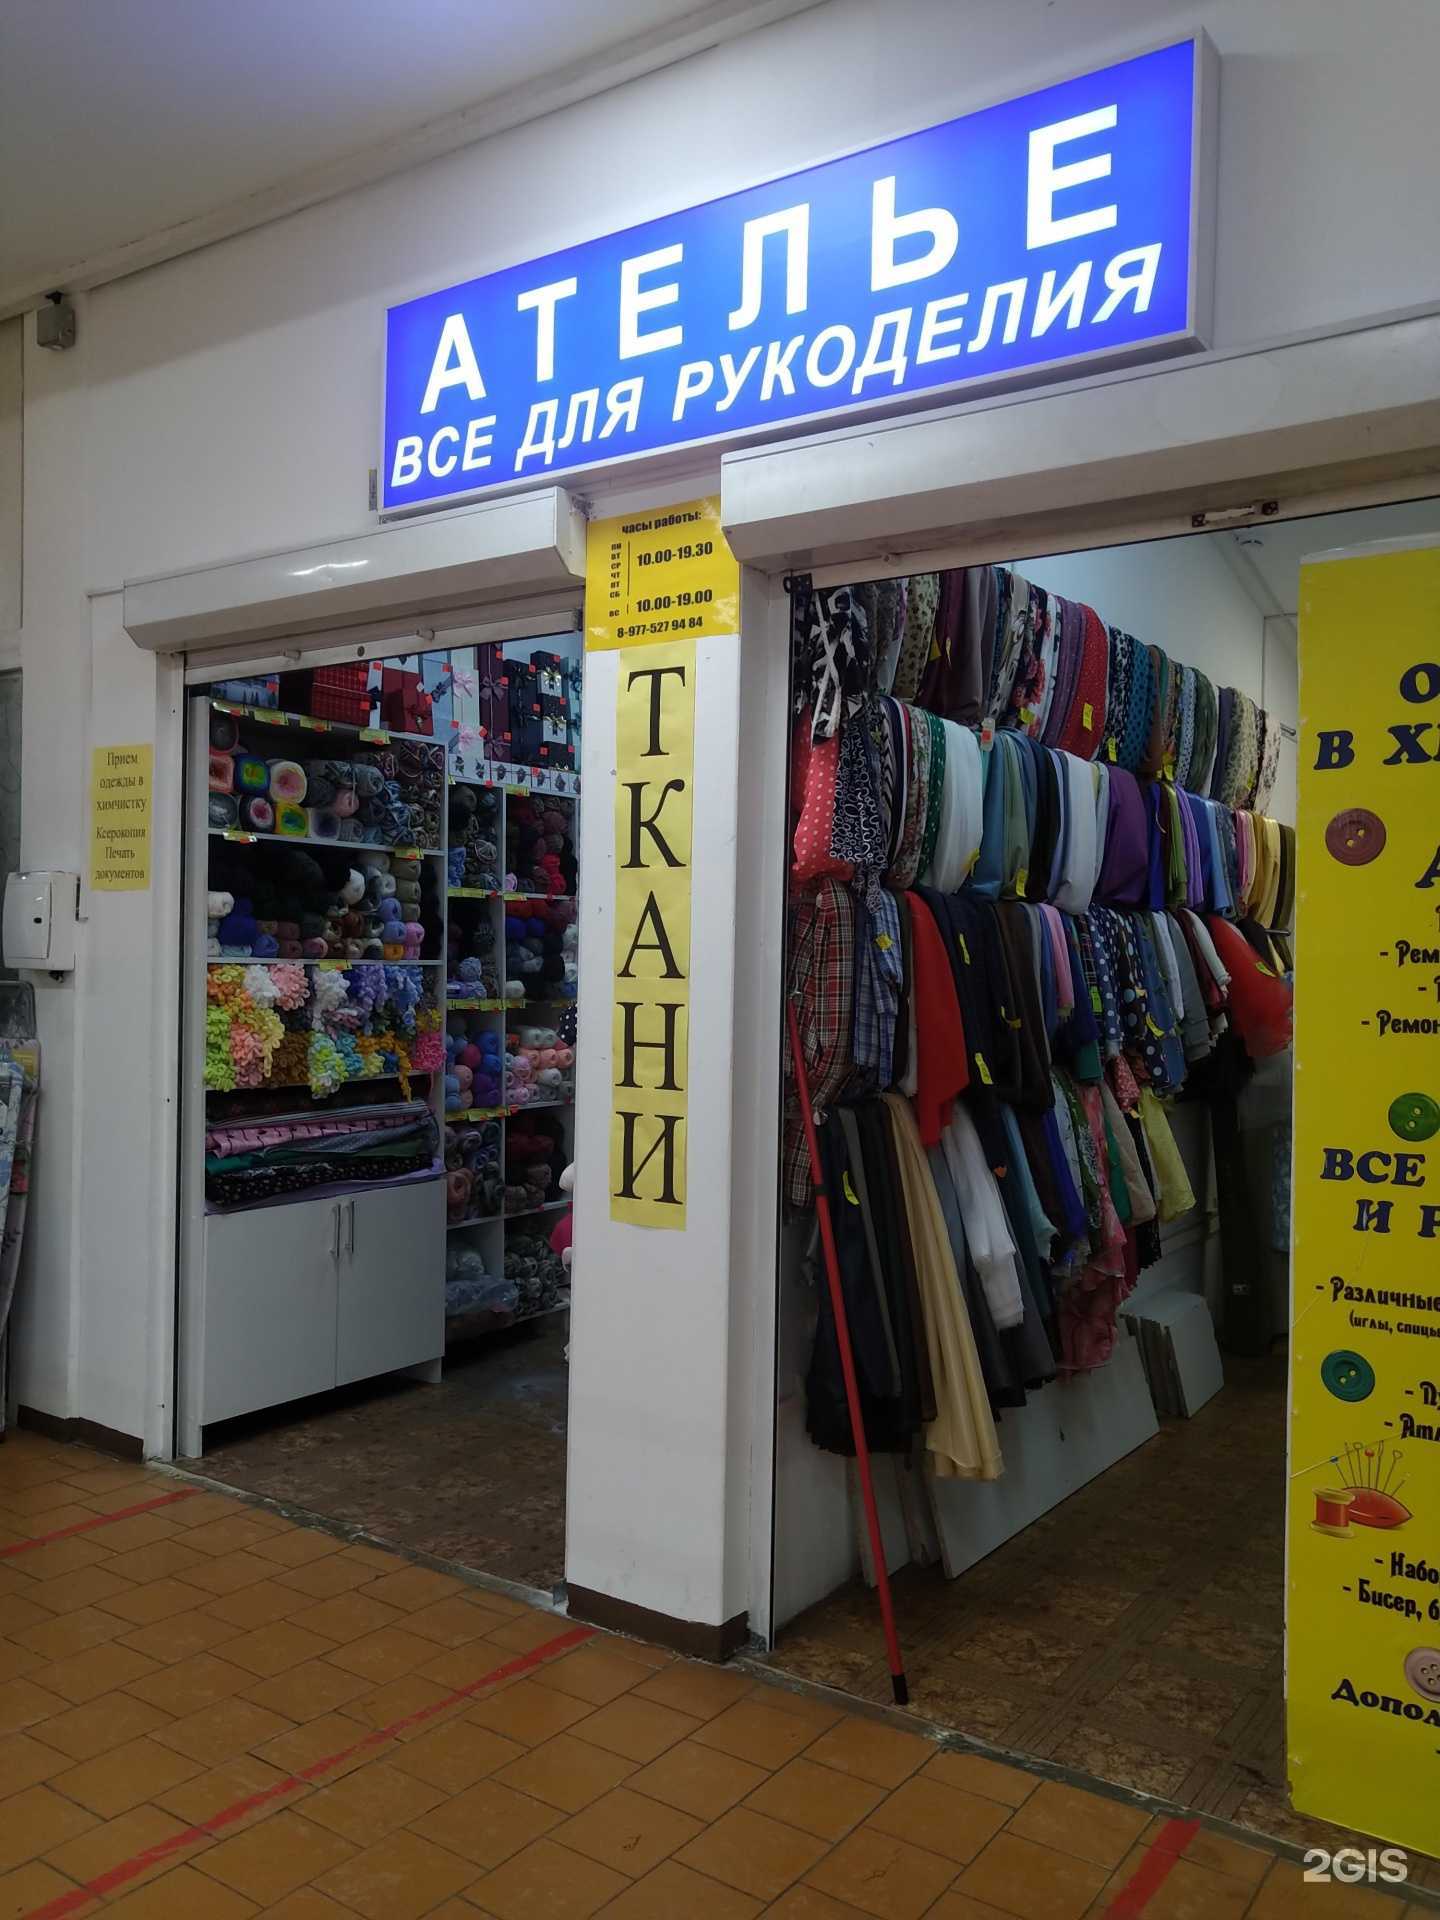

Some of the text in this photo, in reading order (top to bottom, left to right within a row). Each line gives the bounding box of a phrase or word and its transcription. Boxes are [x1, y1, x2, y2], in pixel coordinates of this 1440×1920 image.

[421, 104, 1118, 415] АТЕЛЬЕ
[391, 242, 1164, 489] ВСЕ ДЛЯ РУКОДЕЛИЯ
[654, 511, 702, 530] работы:
[637, 541, 713, 566] 10.00-19.30
[636, 589, 713, 613] 10.00-19.00
[617, 616, 703, 639] 8-977-527 94 84
[107, 752, 138, 769] Прием
[1314, 729, 1355, 771] В
[99, 775, 144, 789] одежды в
[96, 798, 146, 813] химчистку
[96, 826, 146, 843] Ксерокопия
[105, 846, 136, 860] Печать
[95, 868, 145, 883] документов
[614, 667, 687, 1206] ТКАНИ
[1320, 1147, 1425, 1187] ВСЕ
[1353, 1198, 1394, 1234] И
[1349, 1308, 1394, 1335] (иглы,
[1359, 1577, 1423, 1622] Бисер,
